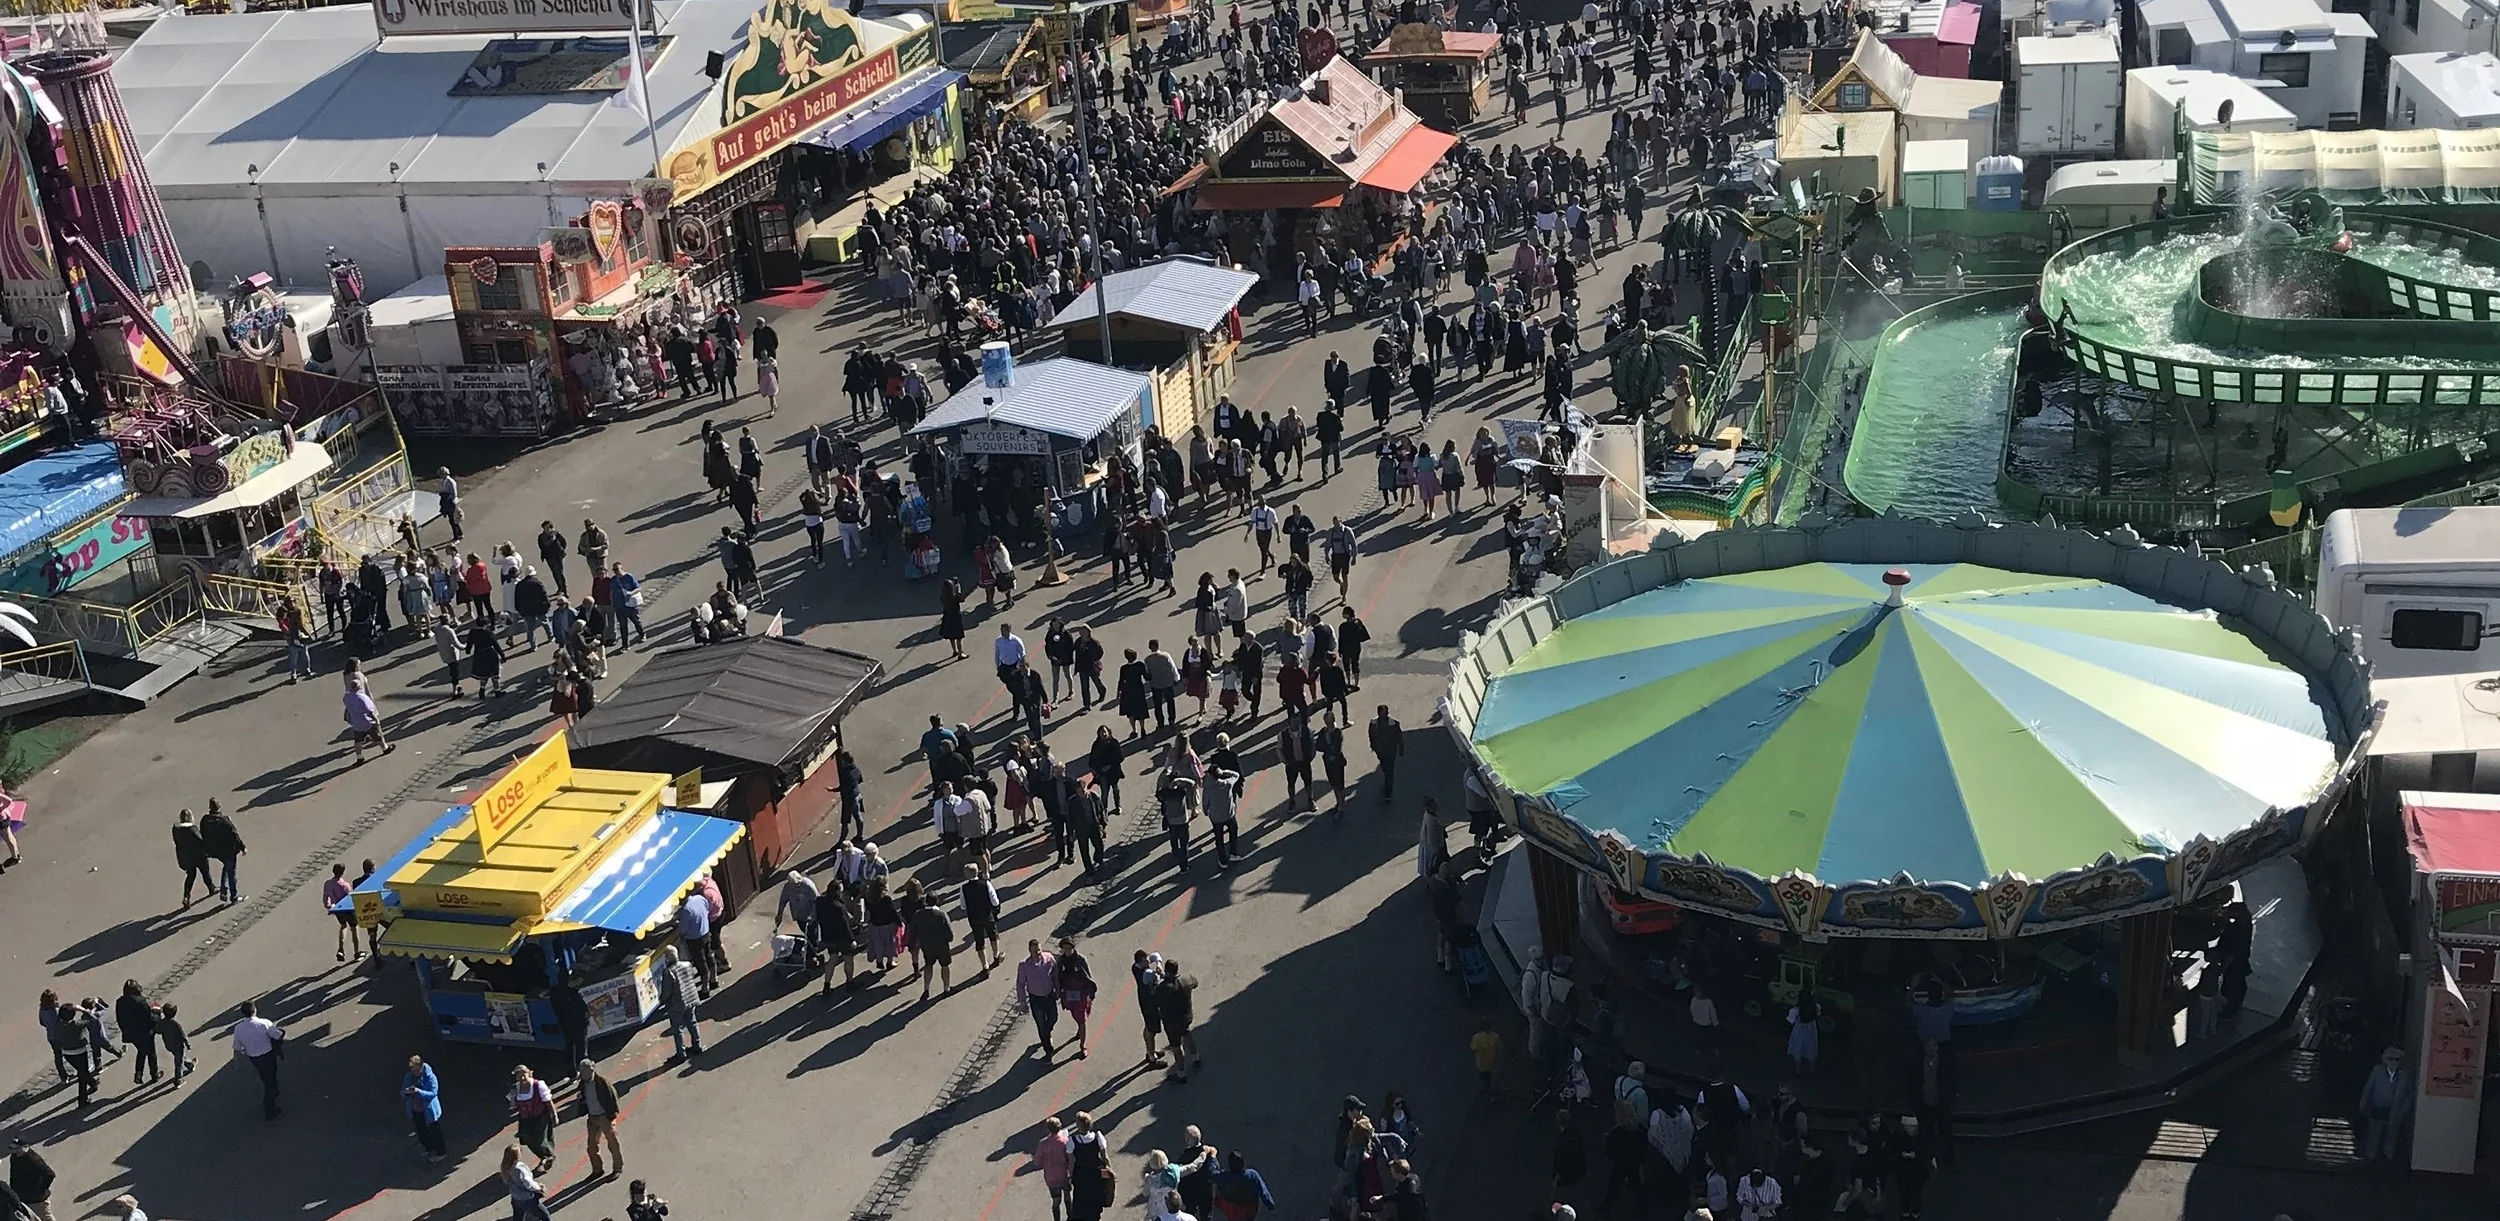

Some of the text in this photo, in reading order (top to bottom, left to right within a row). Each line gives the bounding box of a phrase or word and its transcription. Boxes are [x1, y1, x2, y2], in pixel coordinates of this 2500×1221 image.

[409, 0, 508, 18] Wirtshaus
[514, 0, 536, 16] im
[719, 55, 894, 165] Auf geht's beim Schichtl
[1262, 130, 1291, 143] EIS
[379, 382, 441, 390] rzenmalerei
[965, 431, 1045, 443] OKTOBERFEST
[976, 442, 1036, 452] SOUVENIRS
[486, 780, 525, 825] Lose
[435, 892, 469, 904] Lose
[2453, 882, 2500, 908] EINM
[358, 913, 382, 922] LOTTO
